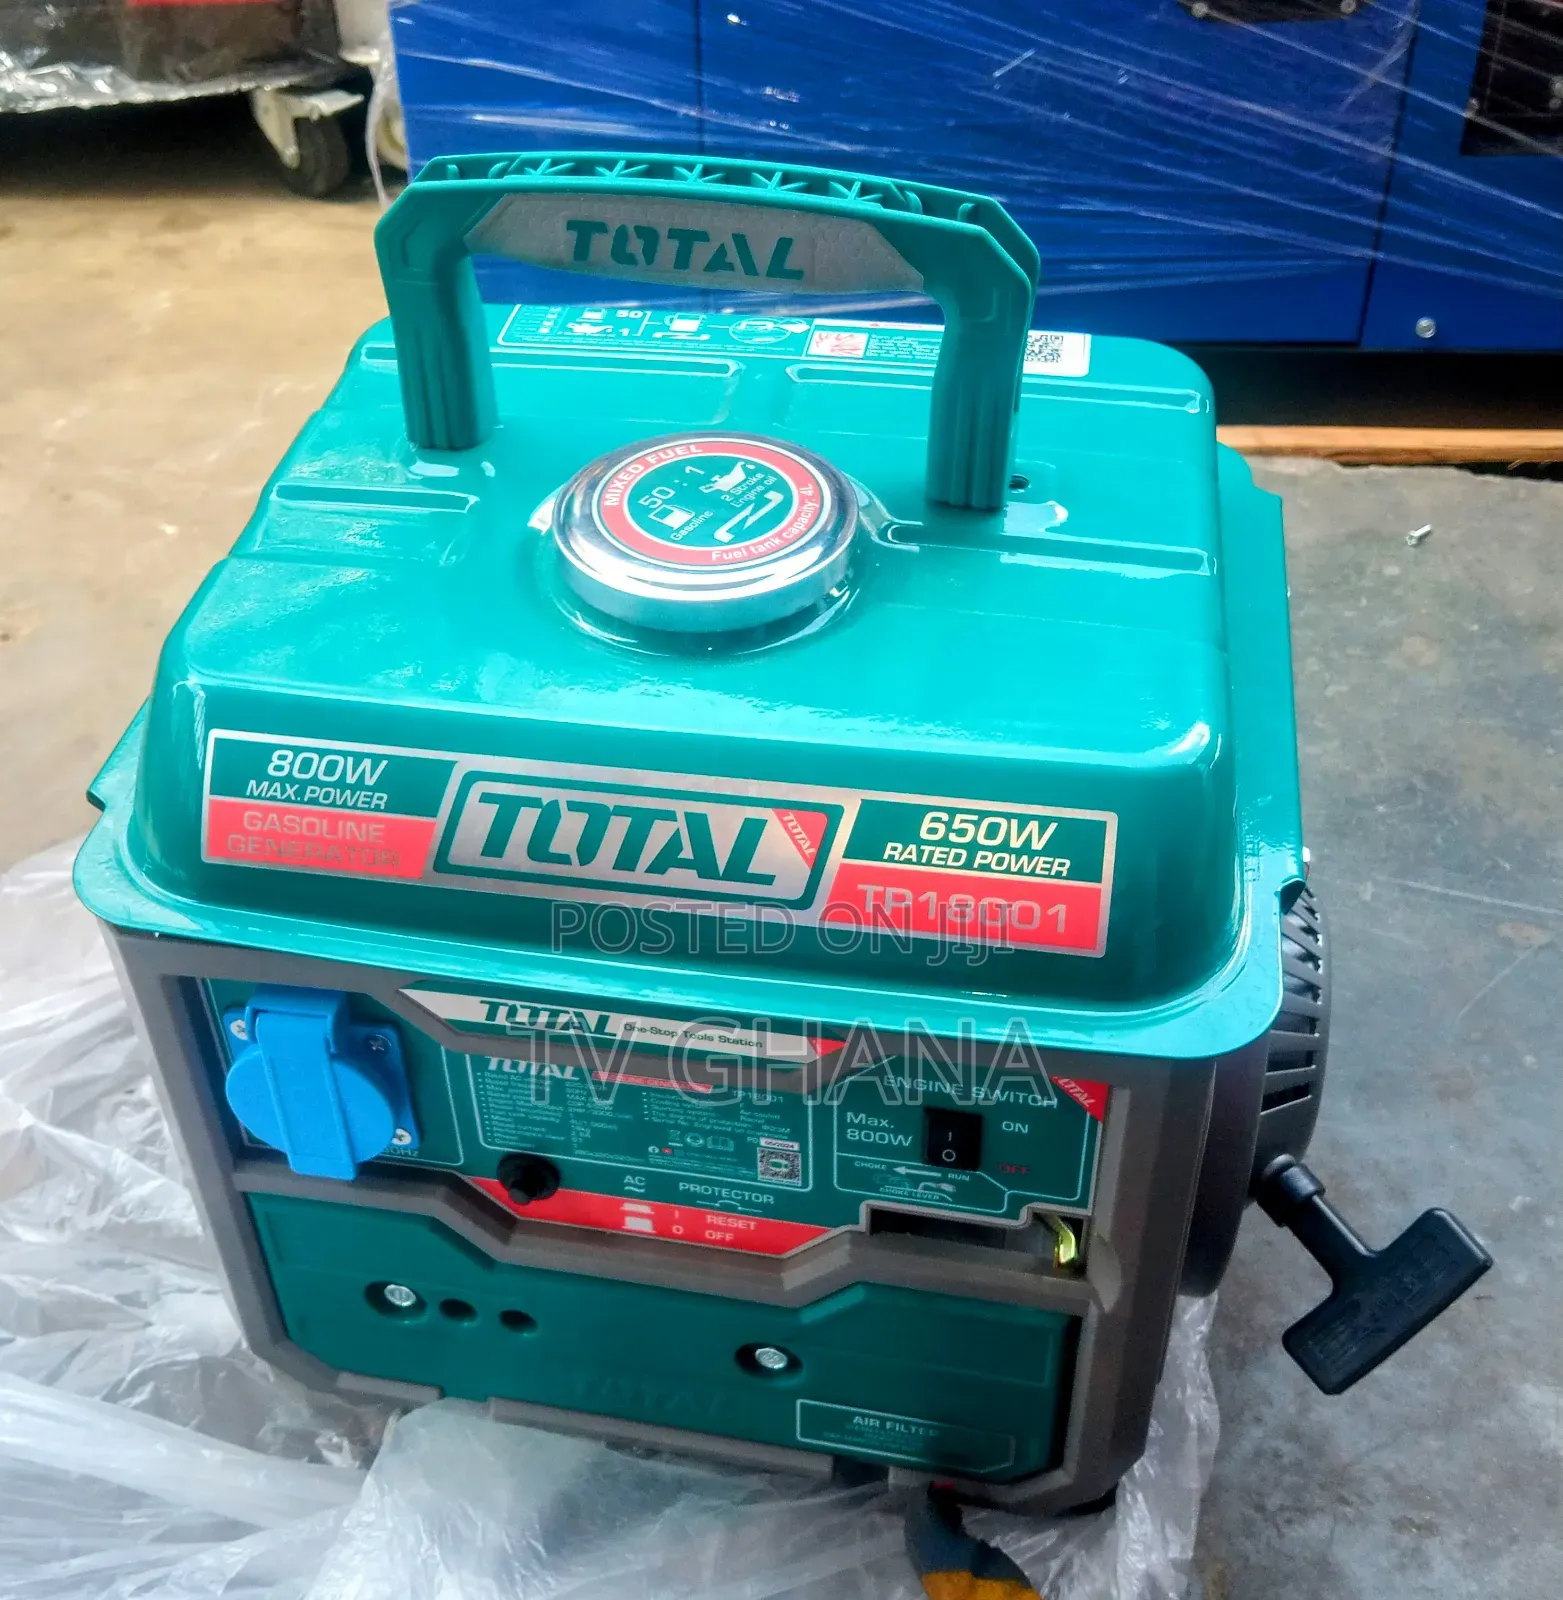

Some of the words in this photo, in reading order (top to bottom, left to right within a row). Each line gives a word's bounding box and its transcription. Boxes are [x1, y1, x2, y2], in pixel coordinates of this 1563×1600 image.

[566, 219, 805, 280] TOTAL
[604, 464, 644, 507] MIXED
[646, 444, 703, 464] FUEL
[730, 472, 765, 496] Stroke
[637, 486, 676, 509] 50
[730, 483, 764, 508] Engine
[765, 475, 778, 486] oil
[669, 510, 714, 541] Gasoline
[711, 549, 748, 561] Fuel
[750, 537, 785, 555] tank
[267, 749, 388, 786] 800W
[243, 810, 385, 842] GASOLINE
[478, 791, 777, 886] TOTAL
[782, 811, 816, 858] TOTAL
[919, 811, 1058, 850] 650W
[227, 834, 398, 869] GENERATOR
[883, 842, 967, 868] RATED
[973, 850, 1071, 877] POWER
[857, 884, 1067, 933] TP18001
[480, 1000, 617, 1037] TOTAL
[624, 1023, 678, 1038] One-Stop
[683, 1030, 714, 1042] Tools
[718, 1034, 763, 1048] Station
[484, 1055, 579, 1080] TOTAL
[882, 1075, 963, 1097] ENGINE
[971, 1086, 1058, 1109] SWITCH
[846, 1128, 913, 1147] 800W
[1001, 1120, 1029, 1134] ON
[854, 1160, 888, 1171] CHOKE
[947, 1172, 970, 1181] RUN
[999, 1162, 1029, 1174] OFF
[624, 1175, 646, 1186] AC
[678, 1181, 775, 1205] PROTECTOR
[705, 1213, 757, 1231] RESET
[704, 1229, 735, 1242] OFF
[852, 1415, 880, 1429] AIR
